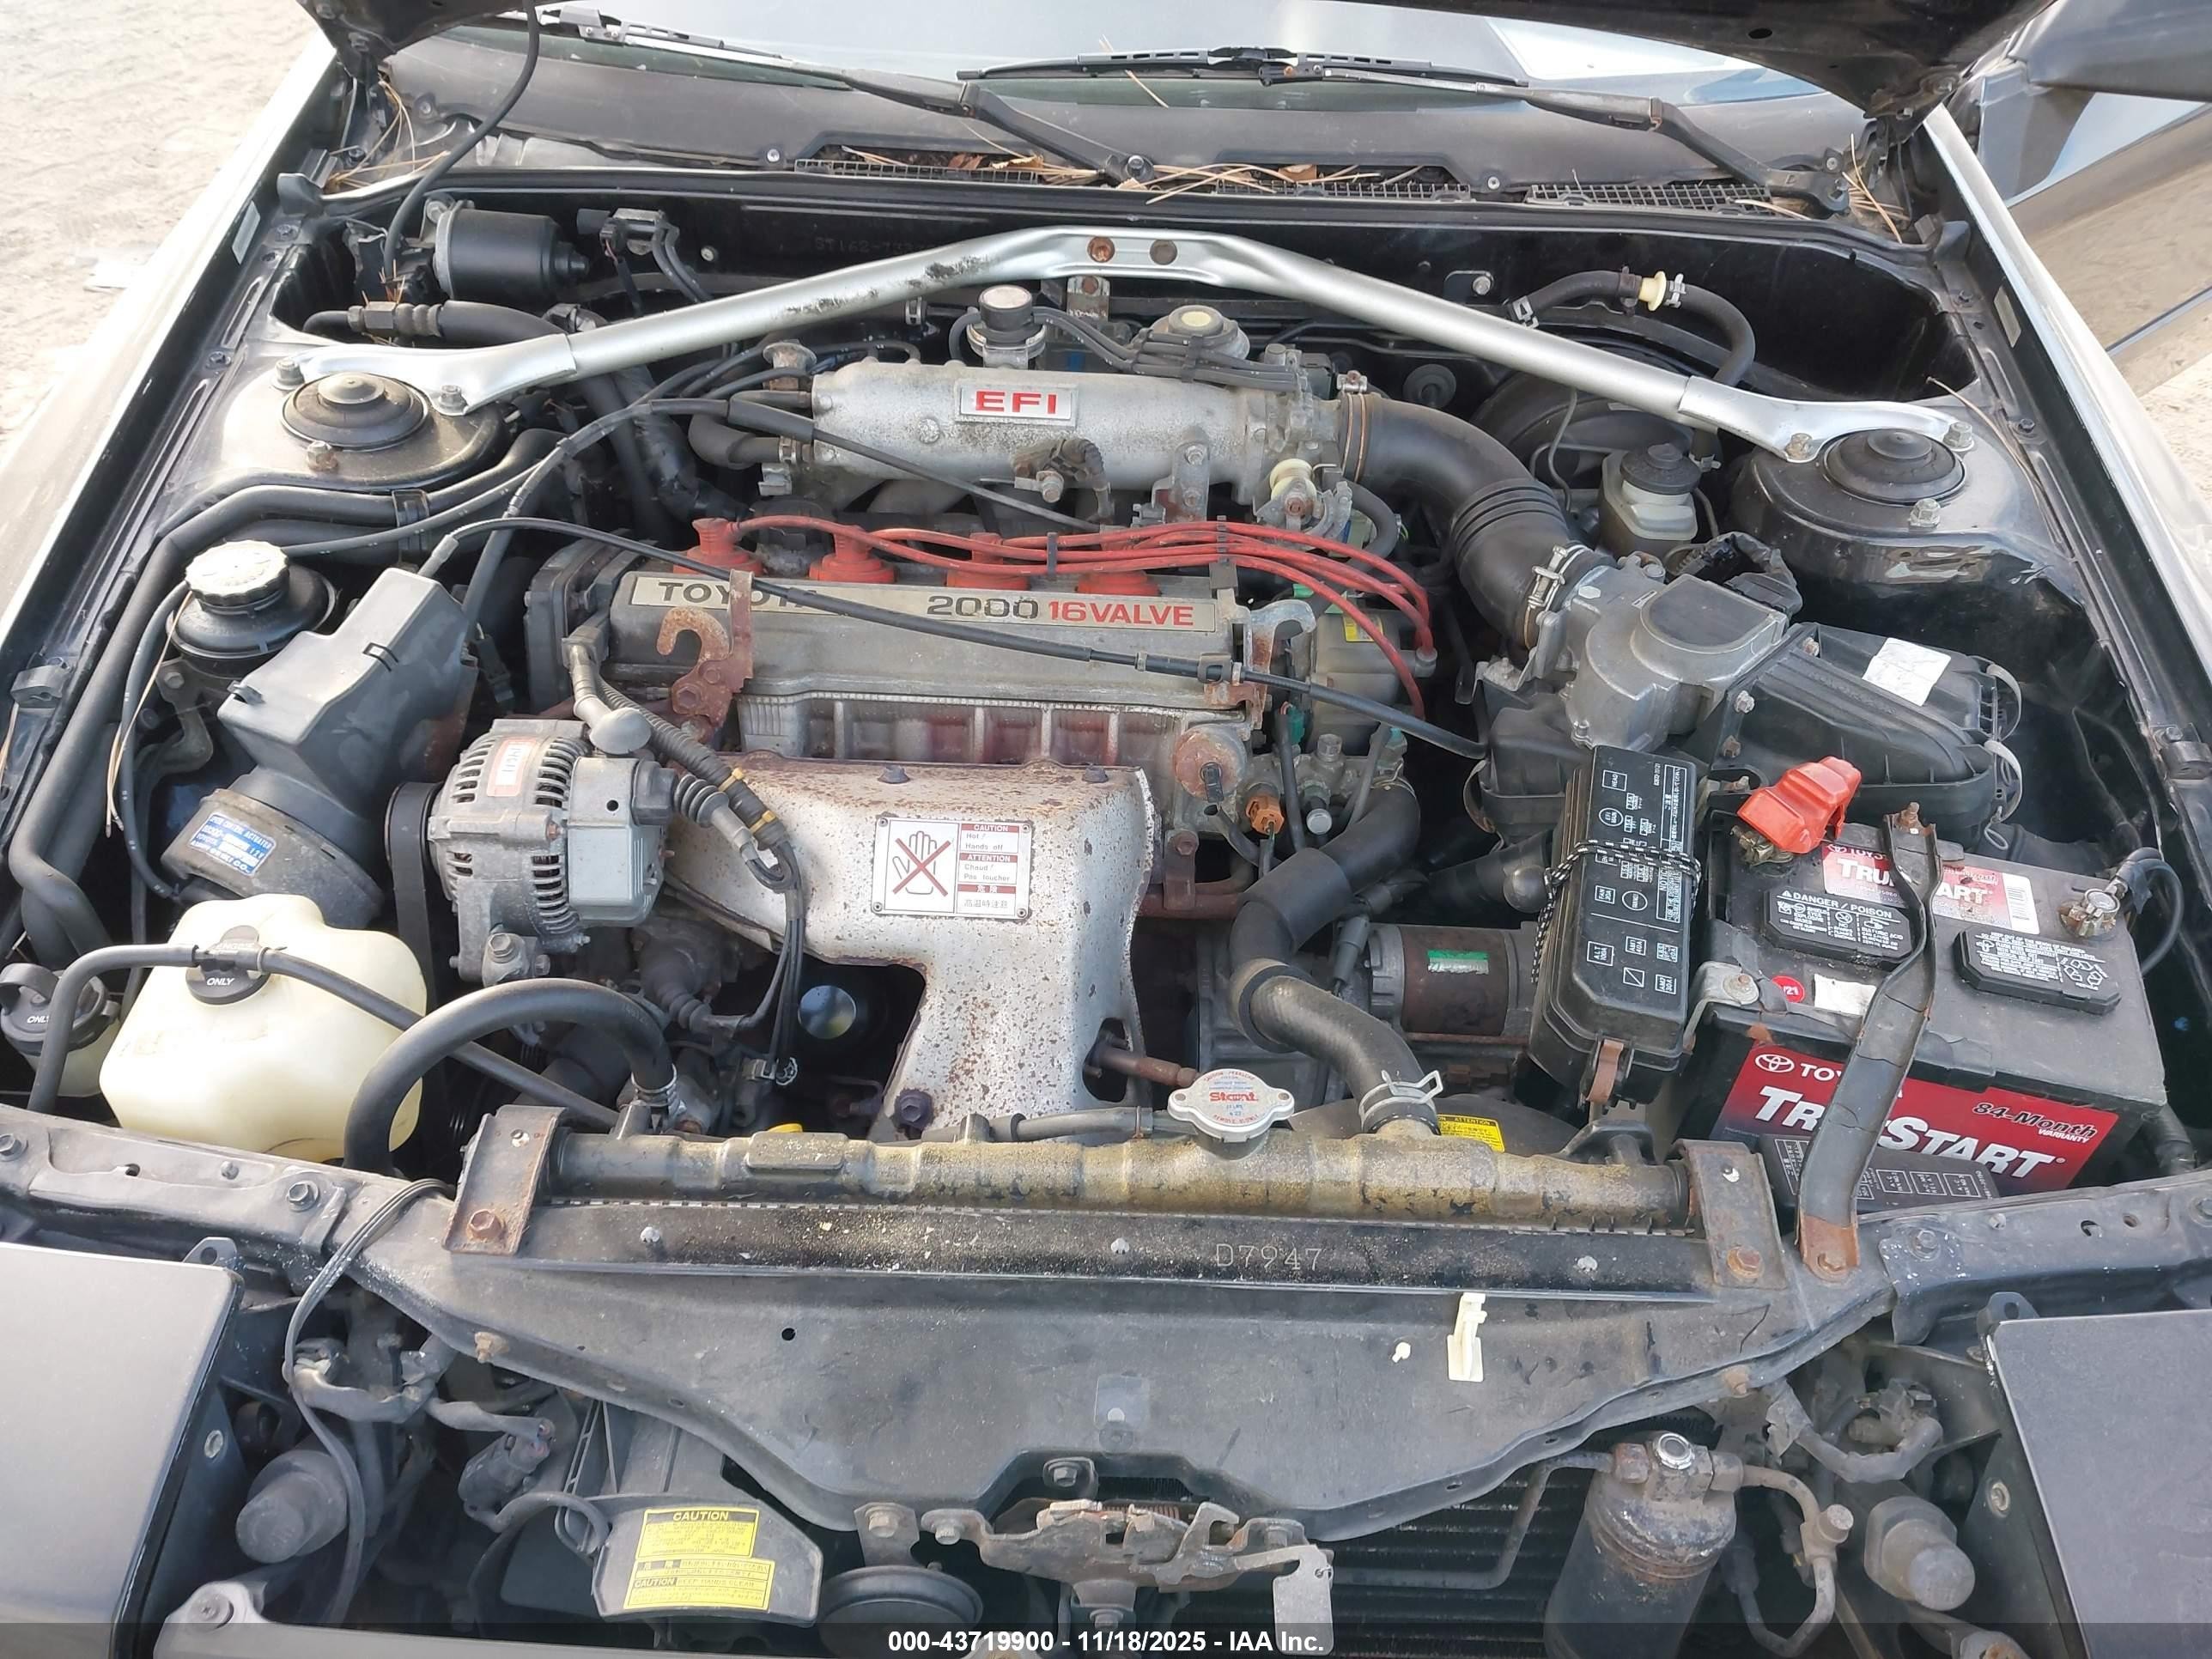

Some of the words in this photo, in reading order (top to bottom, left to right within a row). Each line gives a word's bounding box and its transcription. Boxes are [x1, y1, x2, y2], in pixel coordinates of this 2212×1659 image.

[975, 391, 1057, 414] EFI
[927, 596, 1039, 620] 2000
[1792, 891, 1839, 908] DANGER
[1850, 904, 1892, 918] POISON
[1209, 1091, 1259, 1102] Stant
[1973, 1103, 2097, 1139] 84-Month
[2039, 1128, 2090, 1144] WARRANTY
[1216, 1243, 1322, 1271] D7947
[673, 1510, 728, 1522] CAUTION
[634, 1577, 675, 1588] CAUTION
